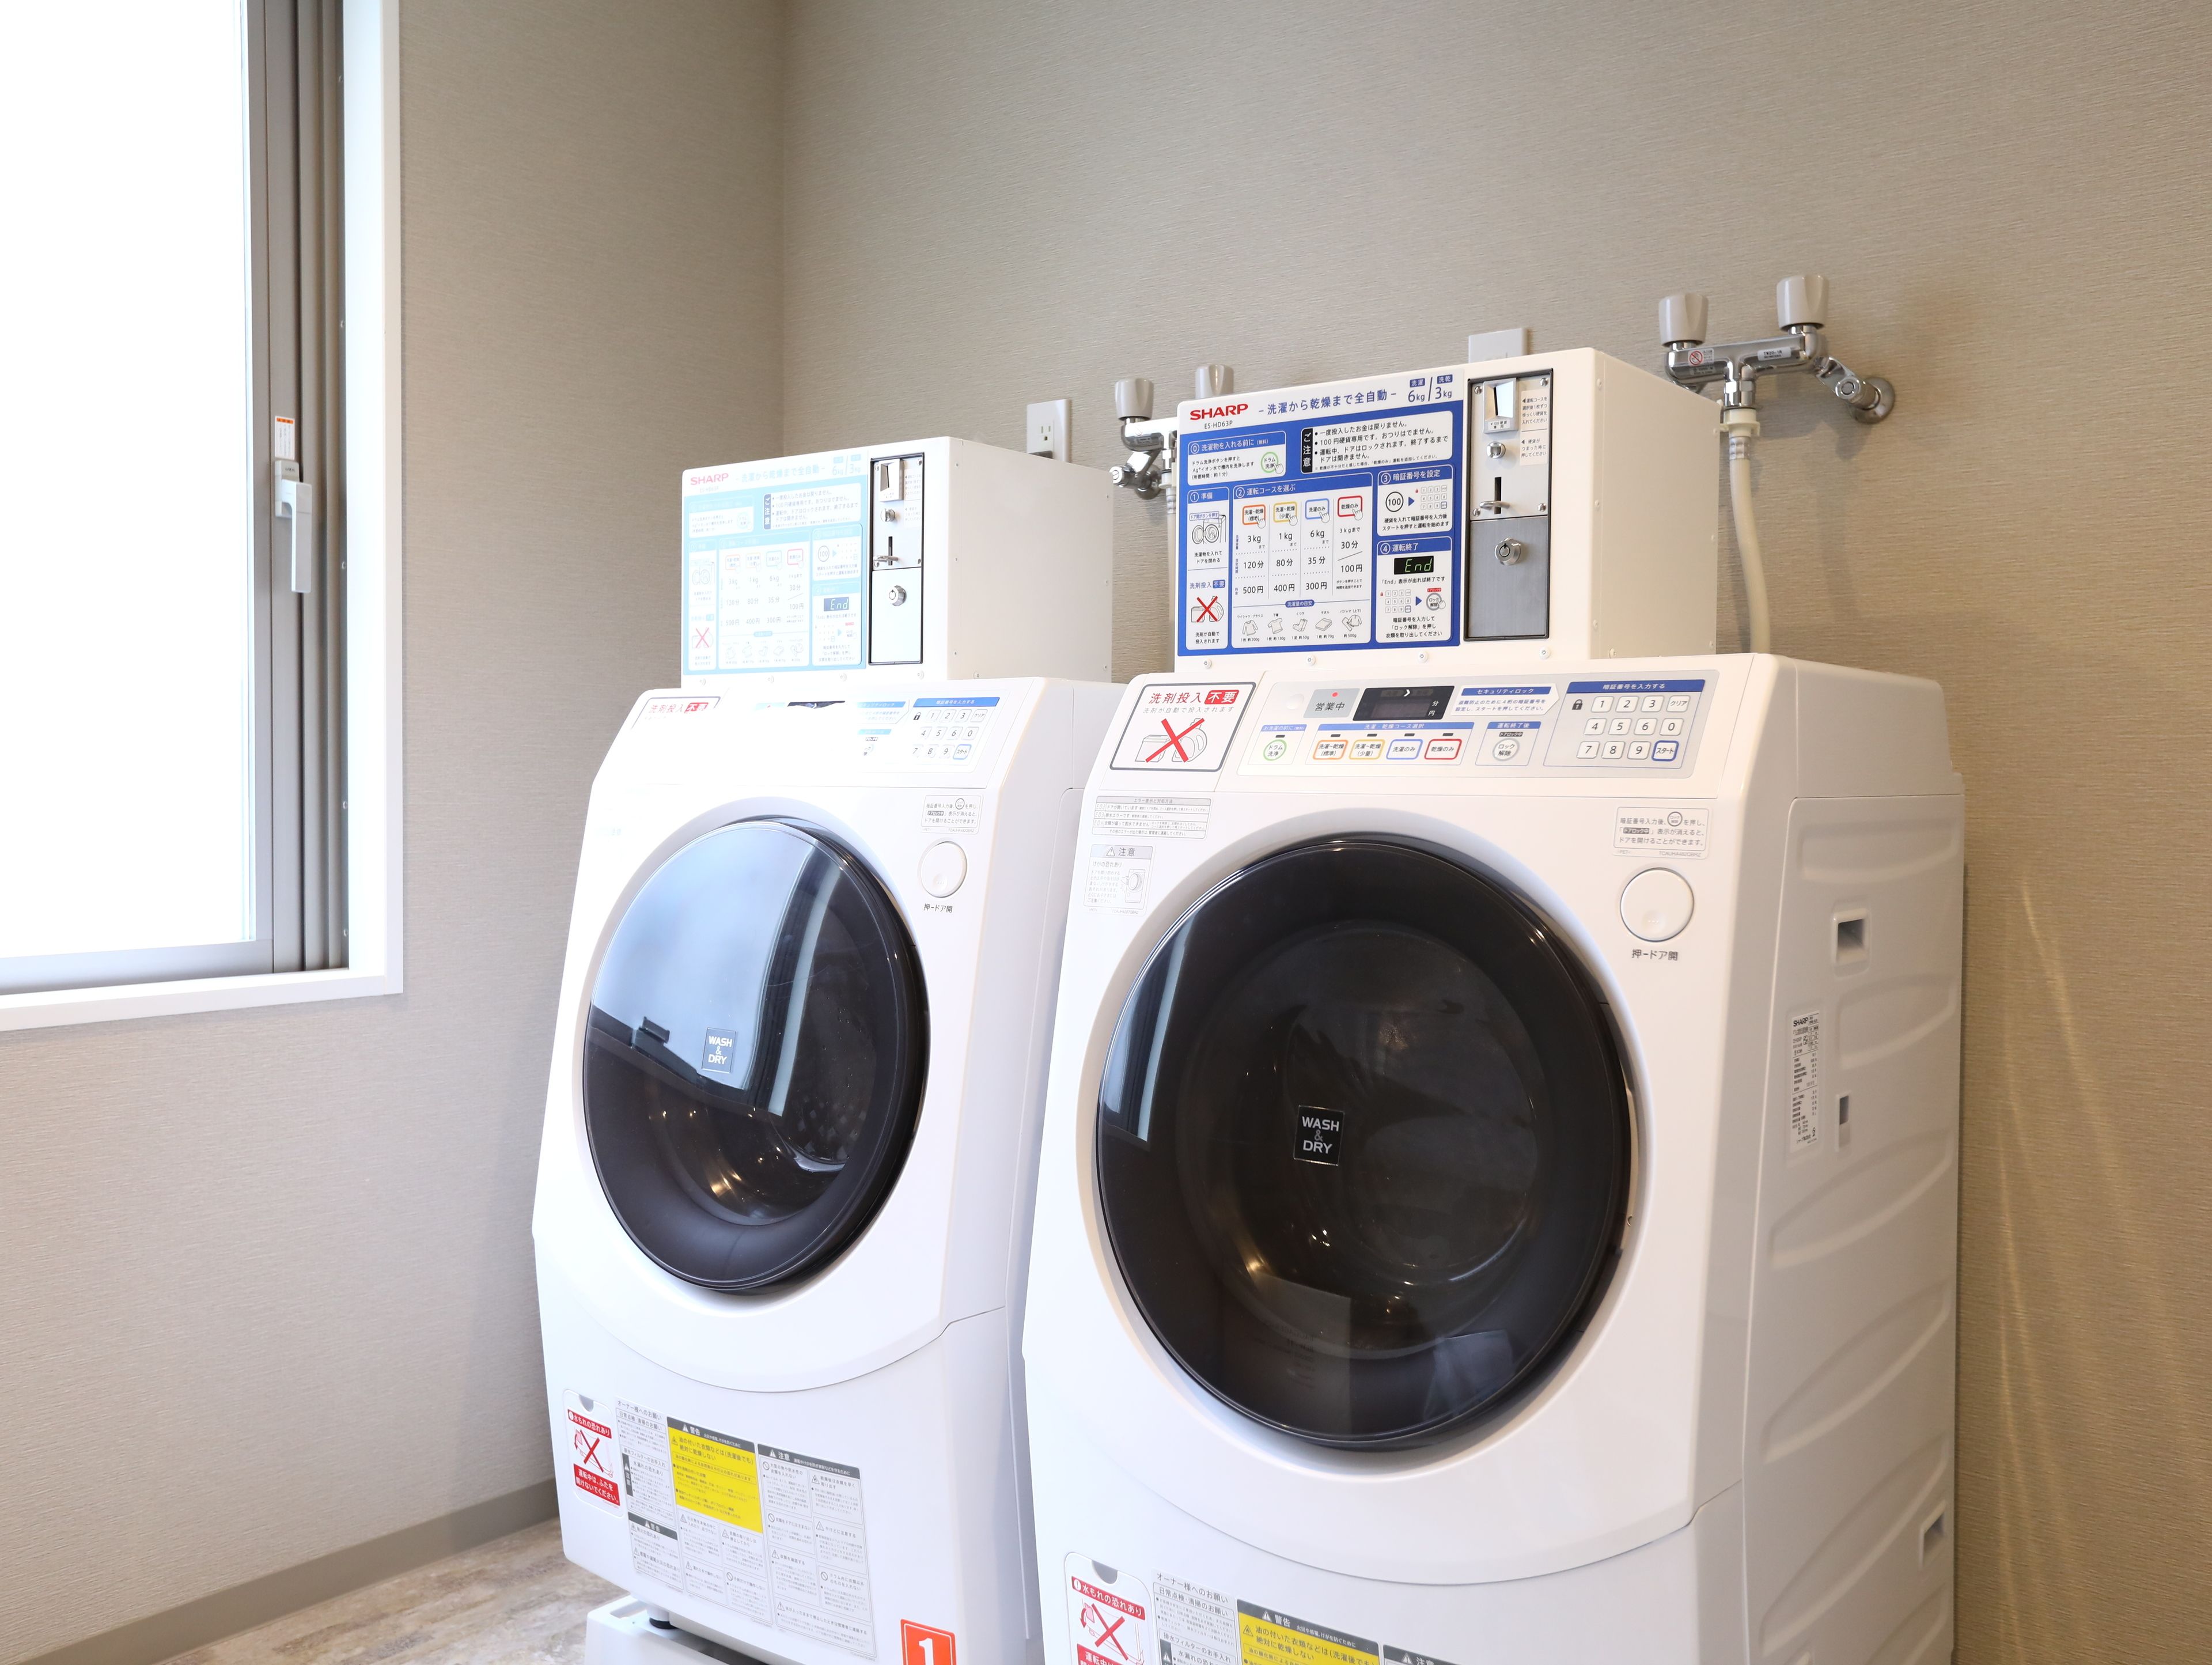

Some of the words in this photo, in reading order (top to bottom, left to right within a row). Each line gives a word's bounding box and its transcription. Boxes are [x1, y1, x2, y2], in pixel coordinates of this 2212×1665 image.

[1411, 379, 1424, 387] 洗濯
[1190, 403, 1248, 421] SHARP
[1204, 421, 1233, 429] ES-HD63P
[1201, 439, 1254, 452] 洗濯物を入れる前に
[1302, 433, 1312, 468] ご注意
[690, 472, 729, 486] SHARP
[1393, 469, 1441, 482] 暗証番号を設定
[1247, 483, 1296, 496] 運転コースを選ぶ
[1201, 492, 1213, 500] 準備
[1388, 498, 1401, 506] 100
[1340, 540, 1358, 550] 30分
[1392, 543, 1419, 553] 運転終了
[1244, 560, 1264, 569] 120分
[1276, 558, 1293, 567] 80分
[1404, 558, 1433, 573] End
[1341, 564, 1363, 573] 100円
[1189, 581, 1212, 590] 洗剤投入
[1243, 585, 1263, 594] 500円
[1274, 583, 1295, 592] 400円
[1305, 581, 1327, 591] 300円
[830, 598, 849, 611] End
[1603, 683, 1666, 691] 暗証番号を入力する
[1148, 693, 1202, 704] 洗剤投入
[1207, 691, 1237, 704] 不要
[1315, 702, 1345, 712] 営業中
[1600, 700, 1604, 708] 1
[1623, 700, 1630, 708] 2
[1648, 699, 1656, 708] 3
[1592, 722, 1599, 731] 4
[1616, 722, 1624, 731] 5
[1642, 722, 1649, 731] 6
[1668, 722, 1675, 731] 0
[1585, 746, 1592, 754] 7
[1609, 746, 1617, 754] 8
[1636, 746, 1643, 755] 9
[1118, 847, 1136, 857] 注意
[1793, 1016, 1809, 1027] SHARP
[709, 1035, 733, 1047] WASH
[715, 1046, 722, 1055] &
[708, 1054, 728, 1065] DRY
[1302, 1116, 1339, 1132] WASH
[1314, 1129, 1323, 1142] &
[1303, 1140, 1333, 1154] DRY
[573, 1414, 611, 1436] 水もれの恐れあり
[1156, 1572, 1229, 1604] オーナー様へのお願い
[1082, 1584, 1142, 1617] 水もれの恐れあり
[1274, 1614, 1291, 1628] 警告
[918, 1637, 934, 1665] 1
[1163, 1632, 1232, 1663] 排水フィルターのお手入れ
[1256, 1635, 1315, 1660] 絶対に乾燥しない
